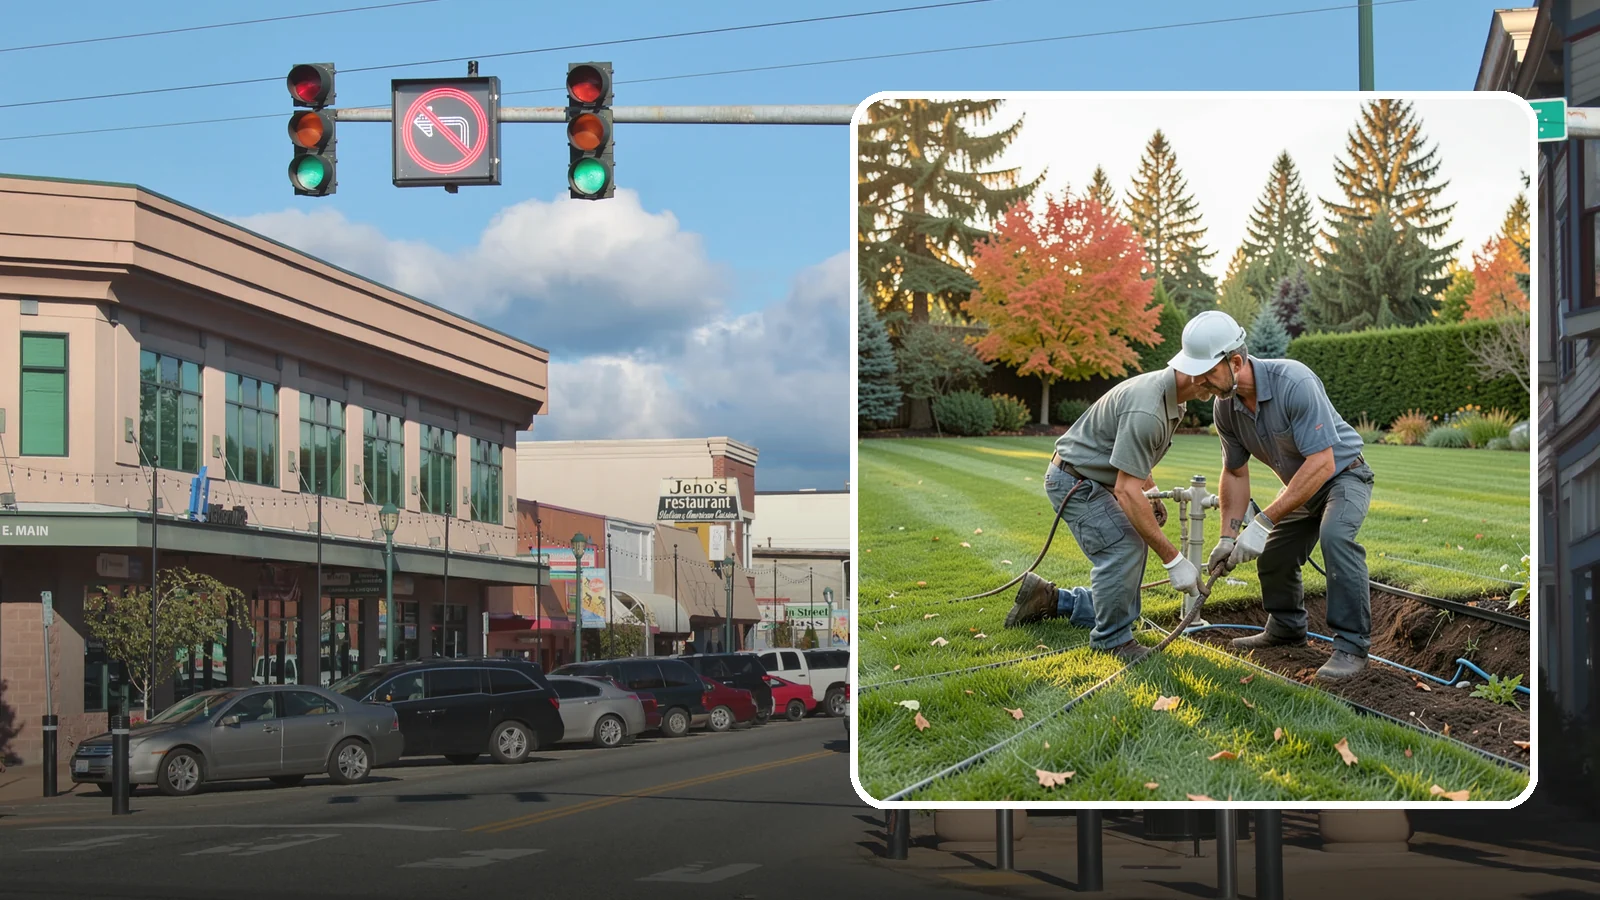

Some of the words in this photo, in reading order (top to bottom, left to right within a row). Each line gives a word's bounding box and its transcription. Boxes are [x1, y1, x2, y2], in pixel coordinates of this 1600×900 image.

[670, 480, 727, 495] Jeno's
[665, 496, 731, 509] restaurant
[658, 510, 681, 520] Italian
[686, 510, 714, 519] American
[715, 509, 737, 519] Cuisine
[2, 525, 13, 536] E.
[15, 525, 49, 536] MAIN
[798, 608, 828, 616] Street
